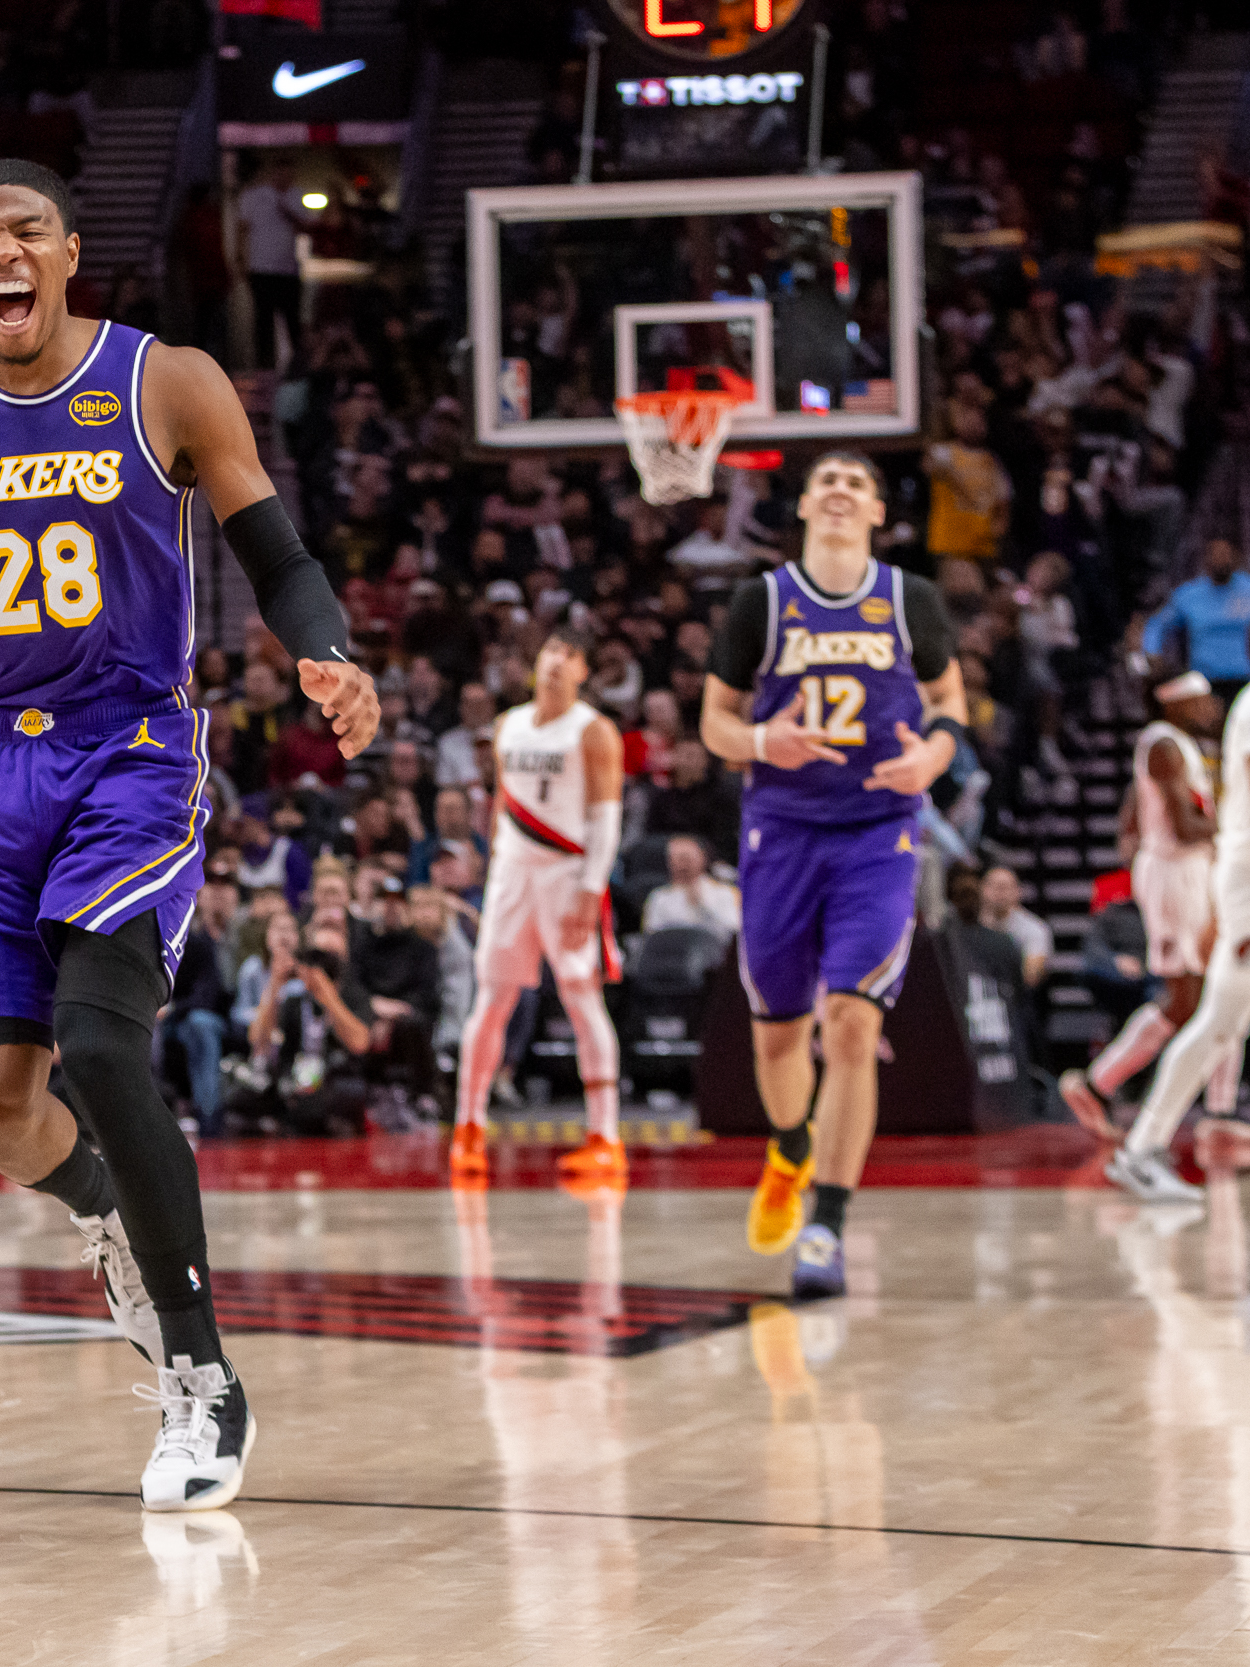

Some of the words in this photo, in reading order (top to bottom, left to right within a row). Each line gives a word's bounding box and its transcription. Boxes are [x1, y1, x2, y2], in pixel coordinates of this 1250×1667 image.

[665, 72, 804, 106] TISSOT
[74, 399, 118, 416] bibigo
[801, 674, 867, 747] 12
